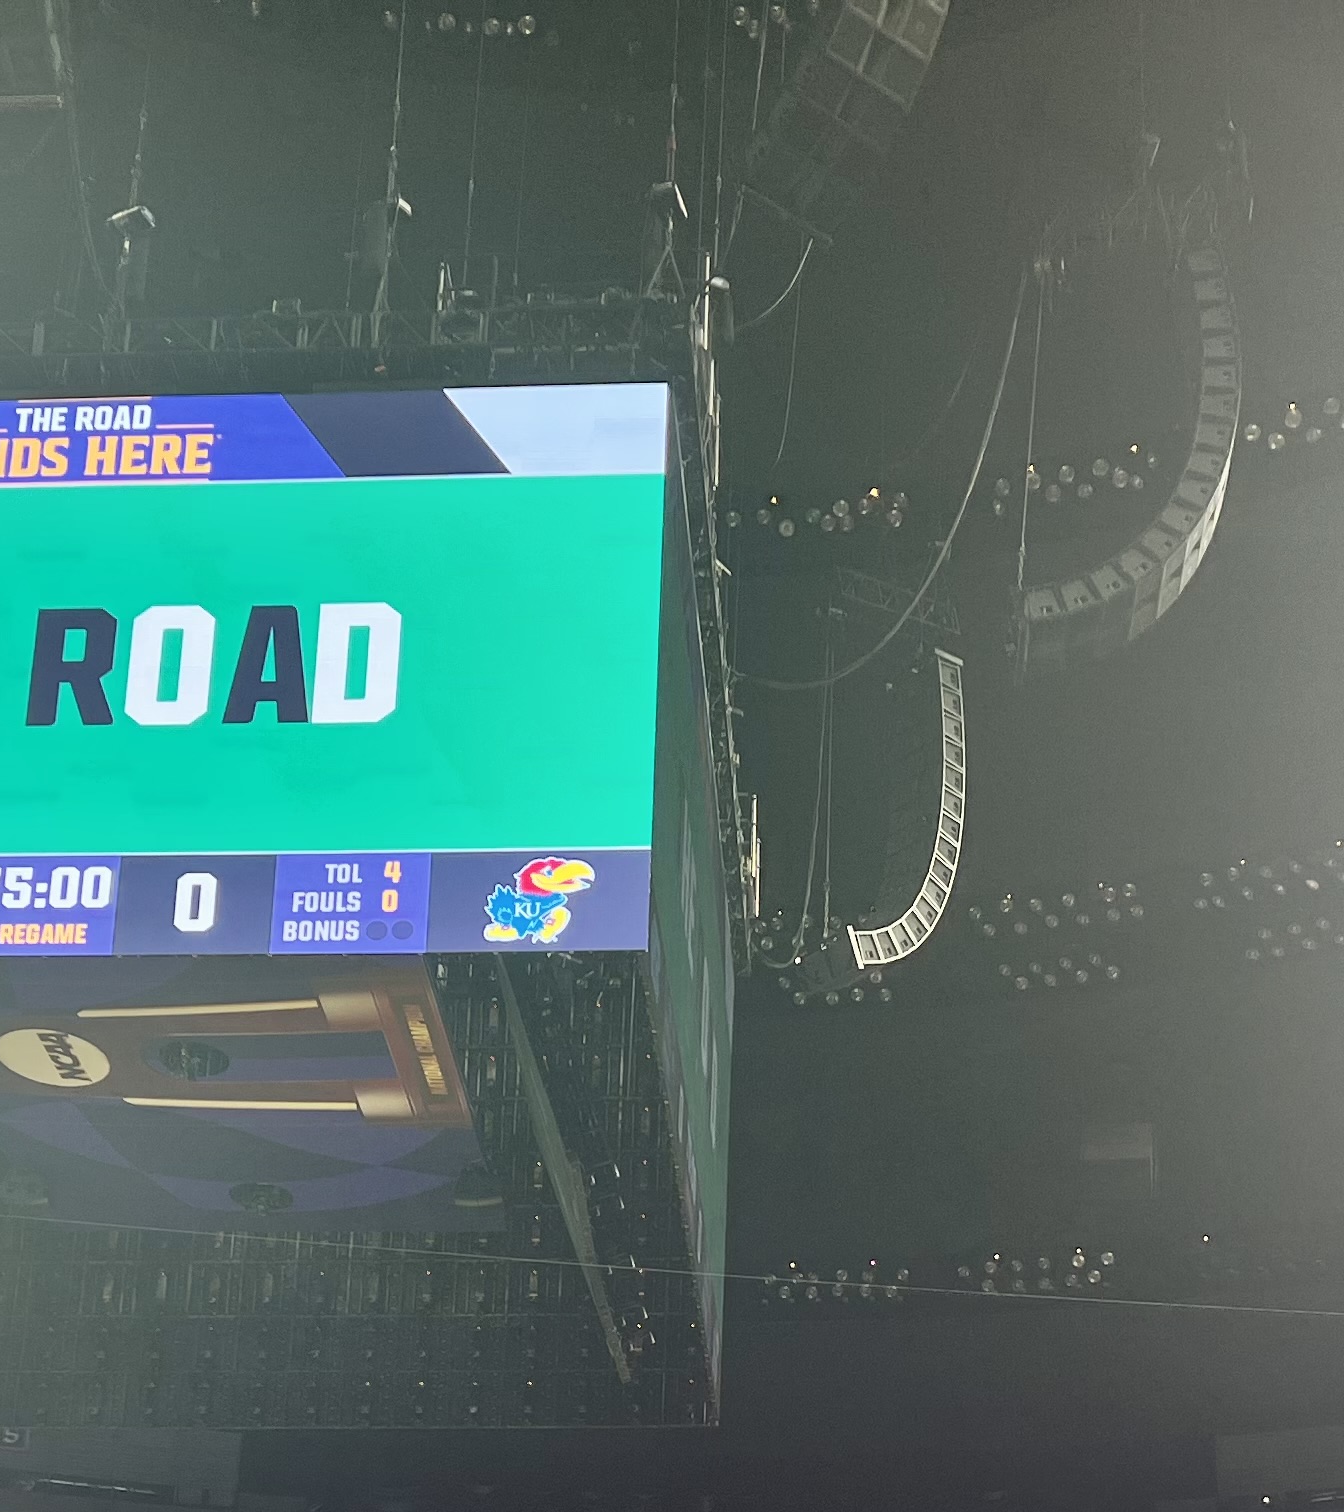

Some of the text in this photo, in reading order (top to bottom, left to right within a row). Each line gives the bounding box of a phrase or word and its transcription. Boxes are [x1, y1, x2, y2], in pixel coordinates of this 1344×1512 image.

[16, 405, 152, 433] THE ROAD
[84, 433, 214, 476] HERE
[24, 601, 402, 727] ROAD
[324, 861, 403, 885] TOL 4
[173, 871, 218, 933] 0
[292, 889, 399, 914] FOULS 0
[513, 901, 542, 919] KU
[282, 920, 360, 942] BONUS
[36, 1032, 94, 1082] NCAA
